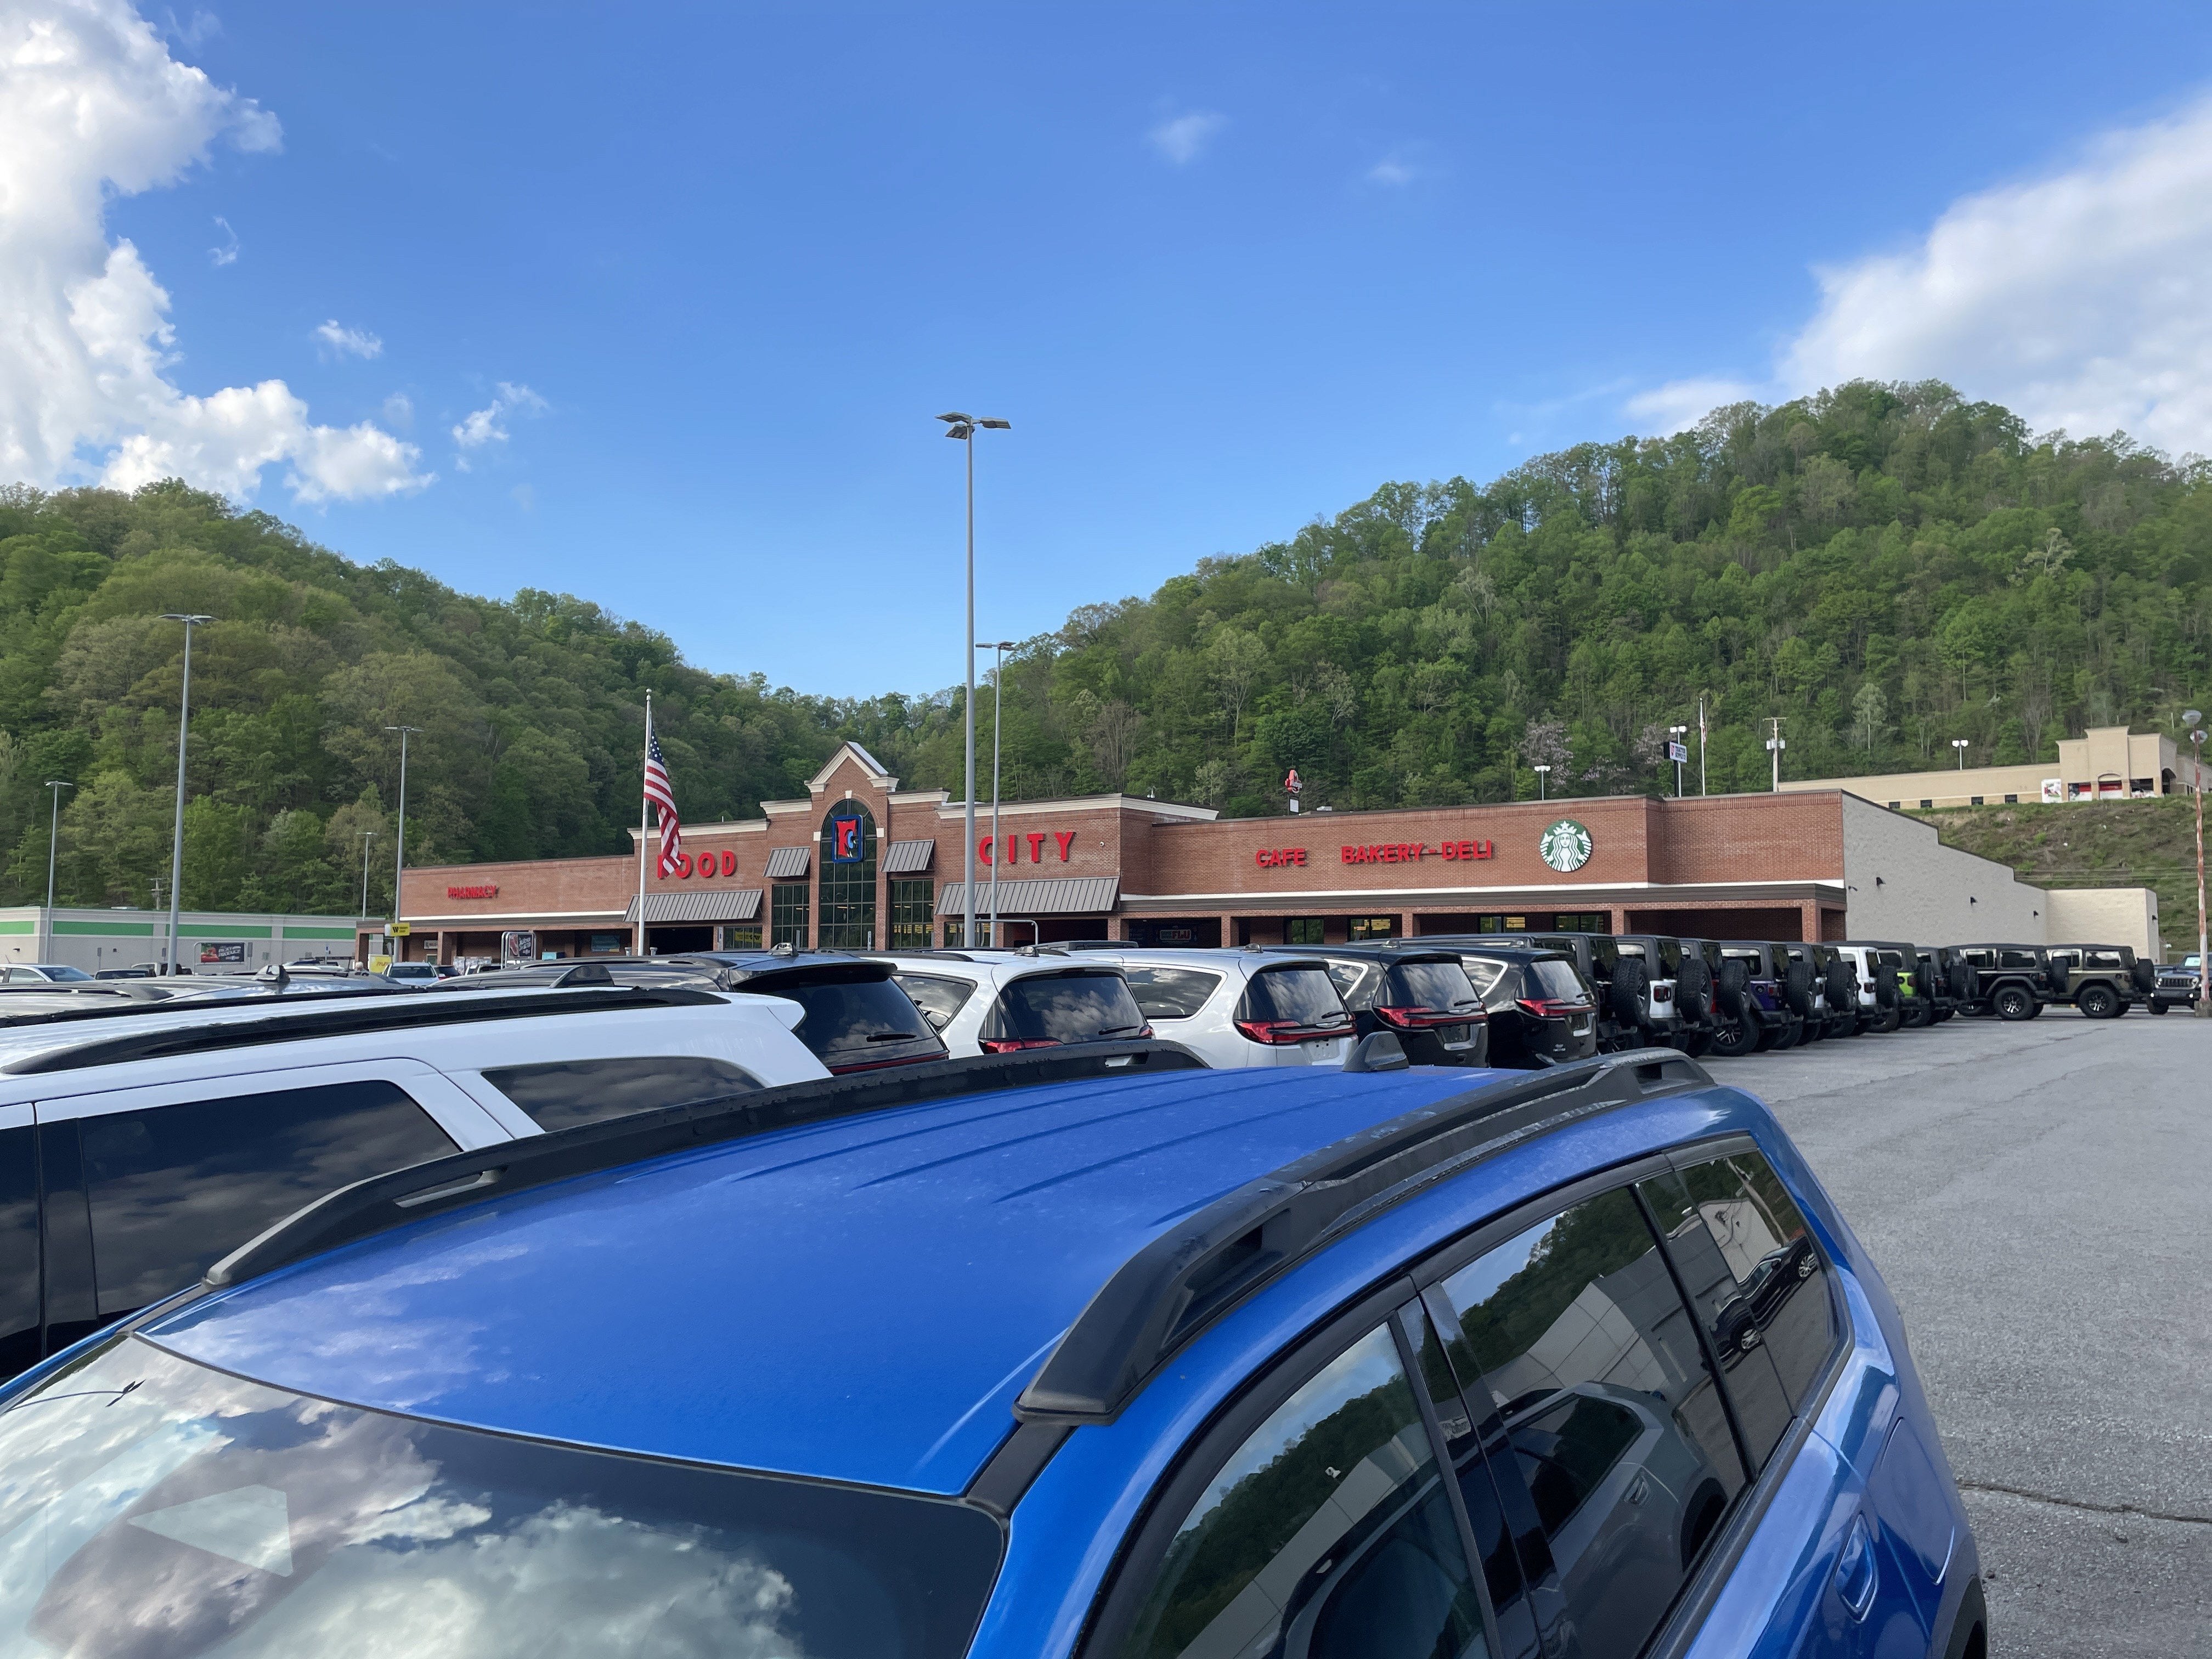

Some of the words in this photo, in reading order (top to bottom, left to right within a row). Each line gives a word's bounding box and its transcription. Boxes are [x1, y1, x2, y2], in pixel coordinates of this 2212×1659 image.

[979, 832, 1074, 865] CITY
[1255, 848, 1306, 867] CAFE
[1341, 843, 1424, 863] BAKERY
[1441, 839, 1492, 860] DELI
[447, 885, 497, 898] PHARMACY
